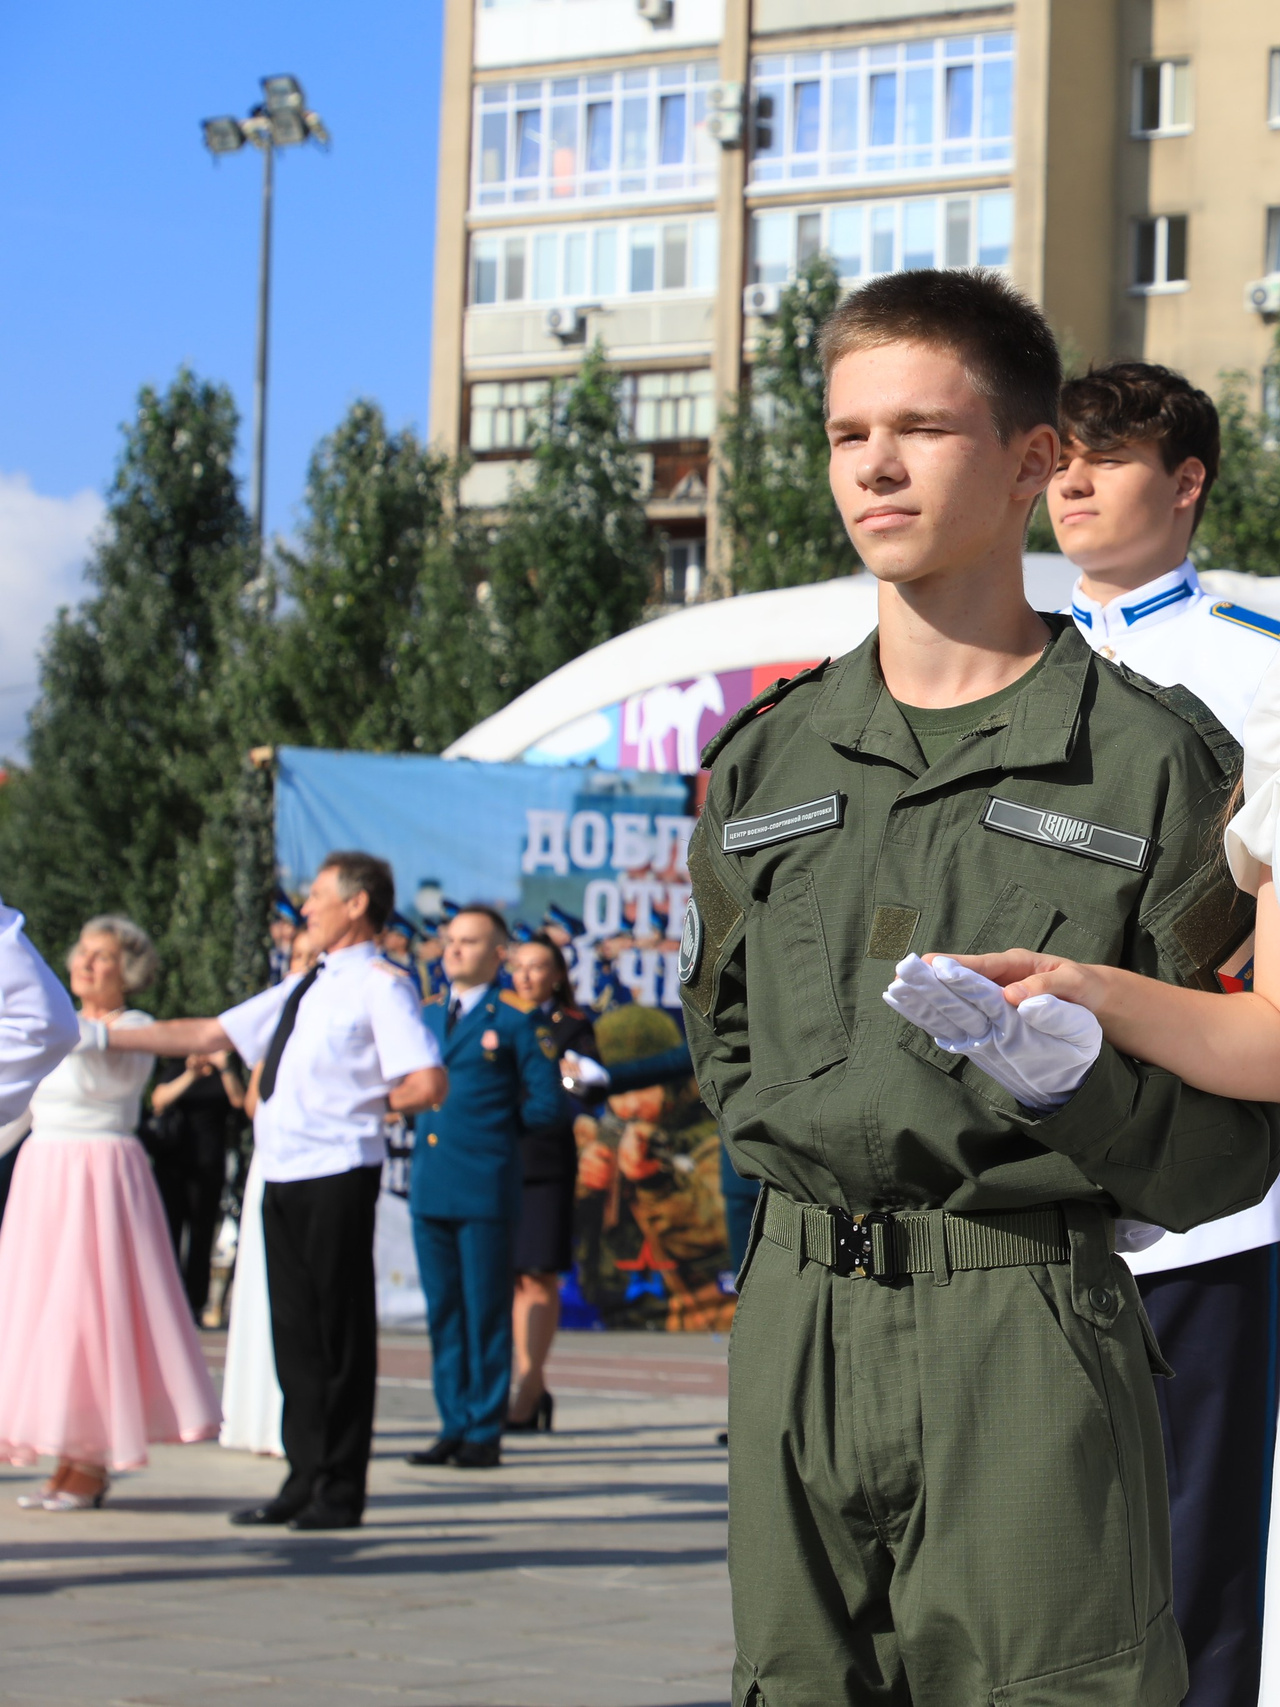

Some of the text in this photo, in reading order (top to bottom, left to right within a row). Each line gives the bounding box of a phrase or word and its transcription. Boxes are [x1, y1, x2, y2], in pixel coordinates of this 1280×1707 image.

[729, 806, 833, 840] ЦЕНТР ВОЕННО-СПОРТИВНОЙ ПОДГОТОВКИ
[1045, 814, 1089, 843] ВОИН
